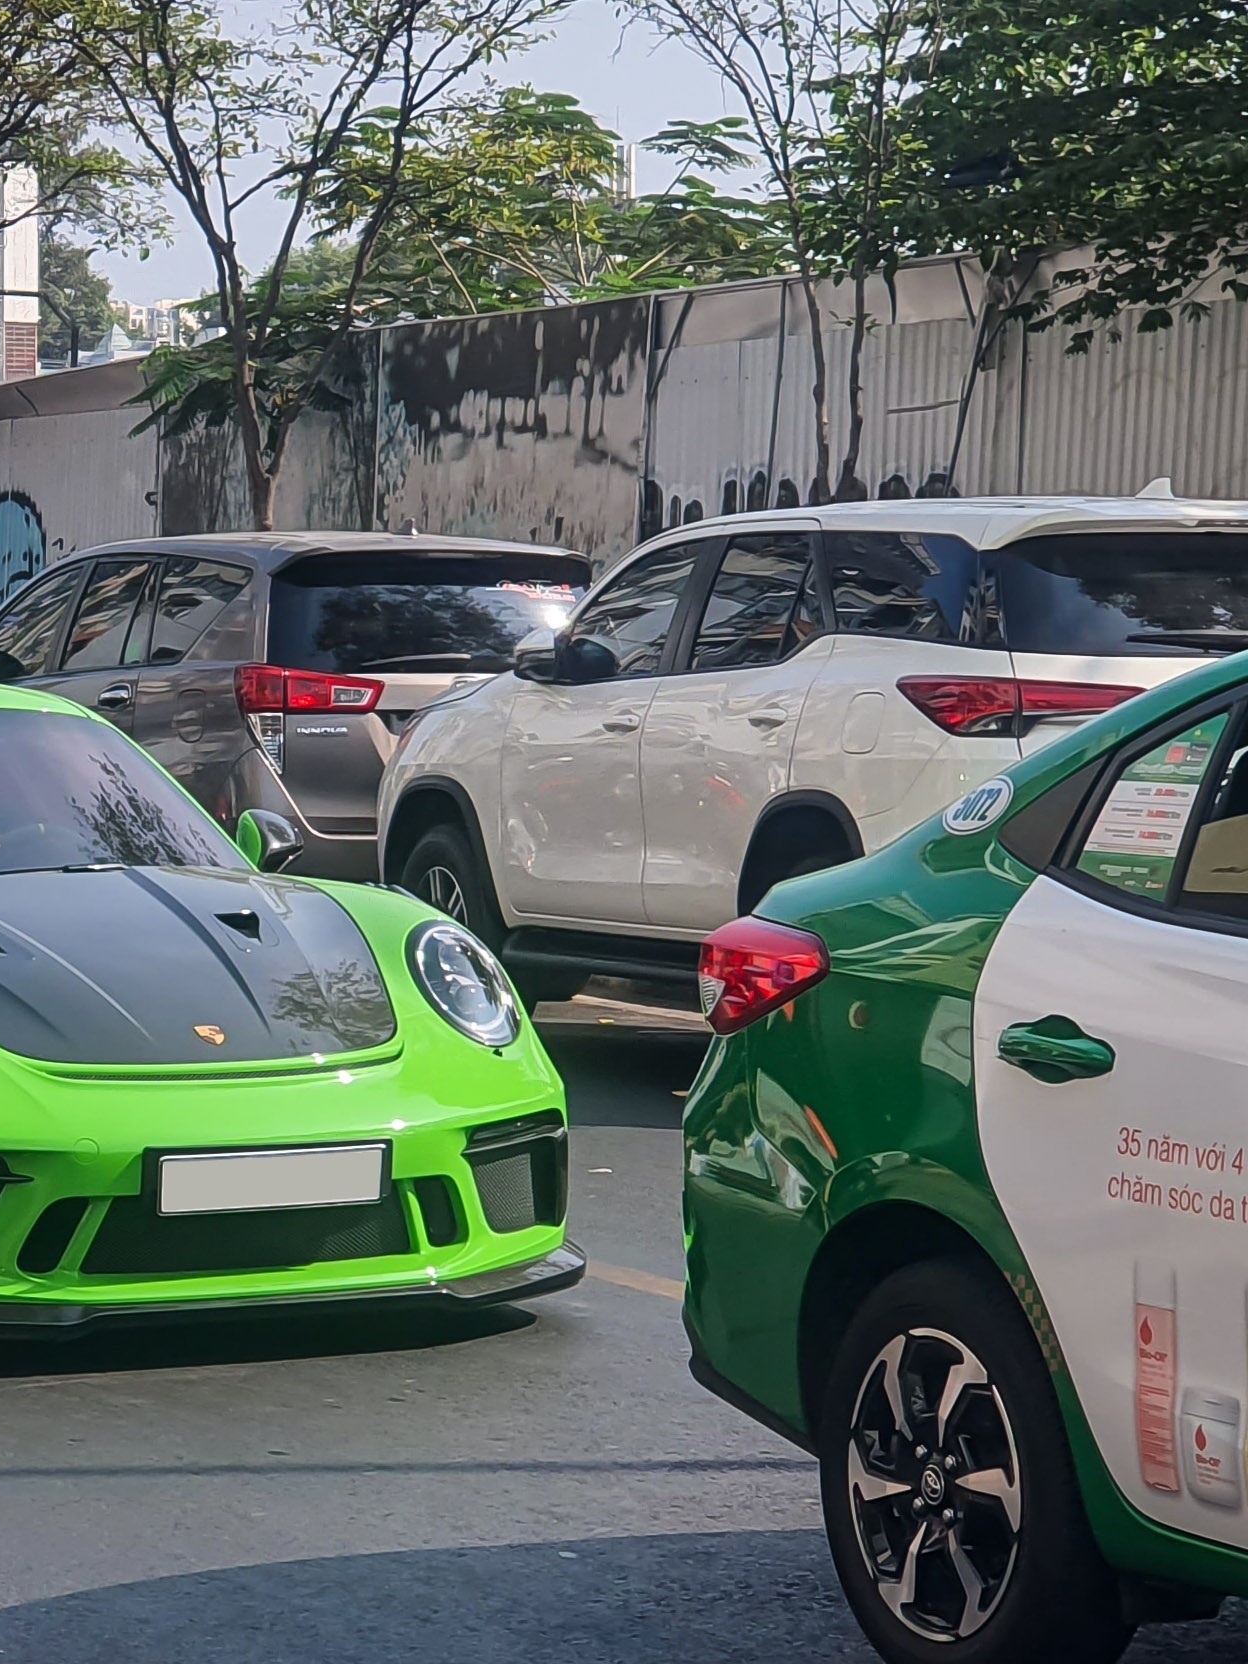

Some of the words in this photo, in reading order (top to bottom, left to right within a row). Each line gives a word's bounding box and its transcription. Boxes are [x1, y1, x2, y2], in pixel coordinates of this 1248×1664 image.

[952, 787, 1003, 821] 5072
[1117, 1126, 1142, 1157] 35
[1147, 1134, 1189, 1165] năm
[1195, 1142, 1226, 1171] với
[1231, 1147, 1244, 1175] 4
[1108, 1171, 1162, 1206] chăm
[1168, 1183, 1203, 1214] sóc
[1210, 1189, 1235, 1221] da
